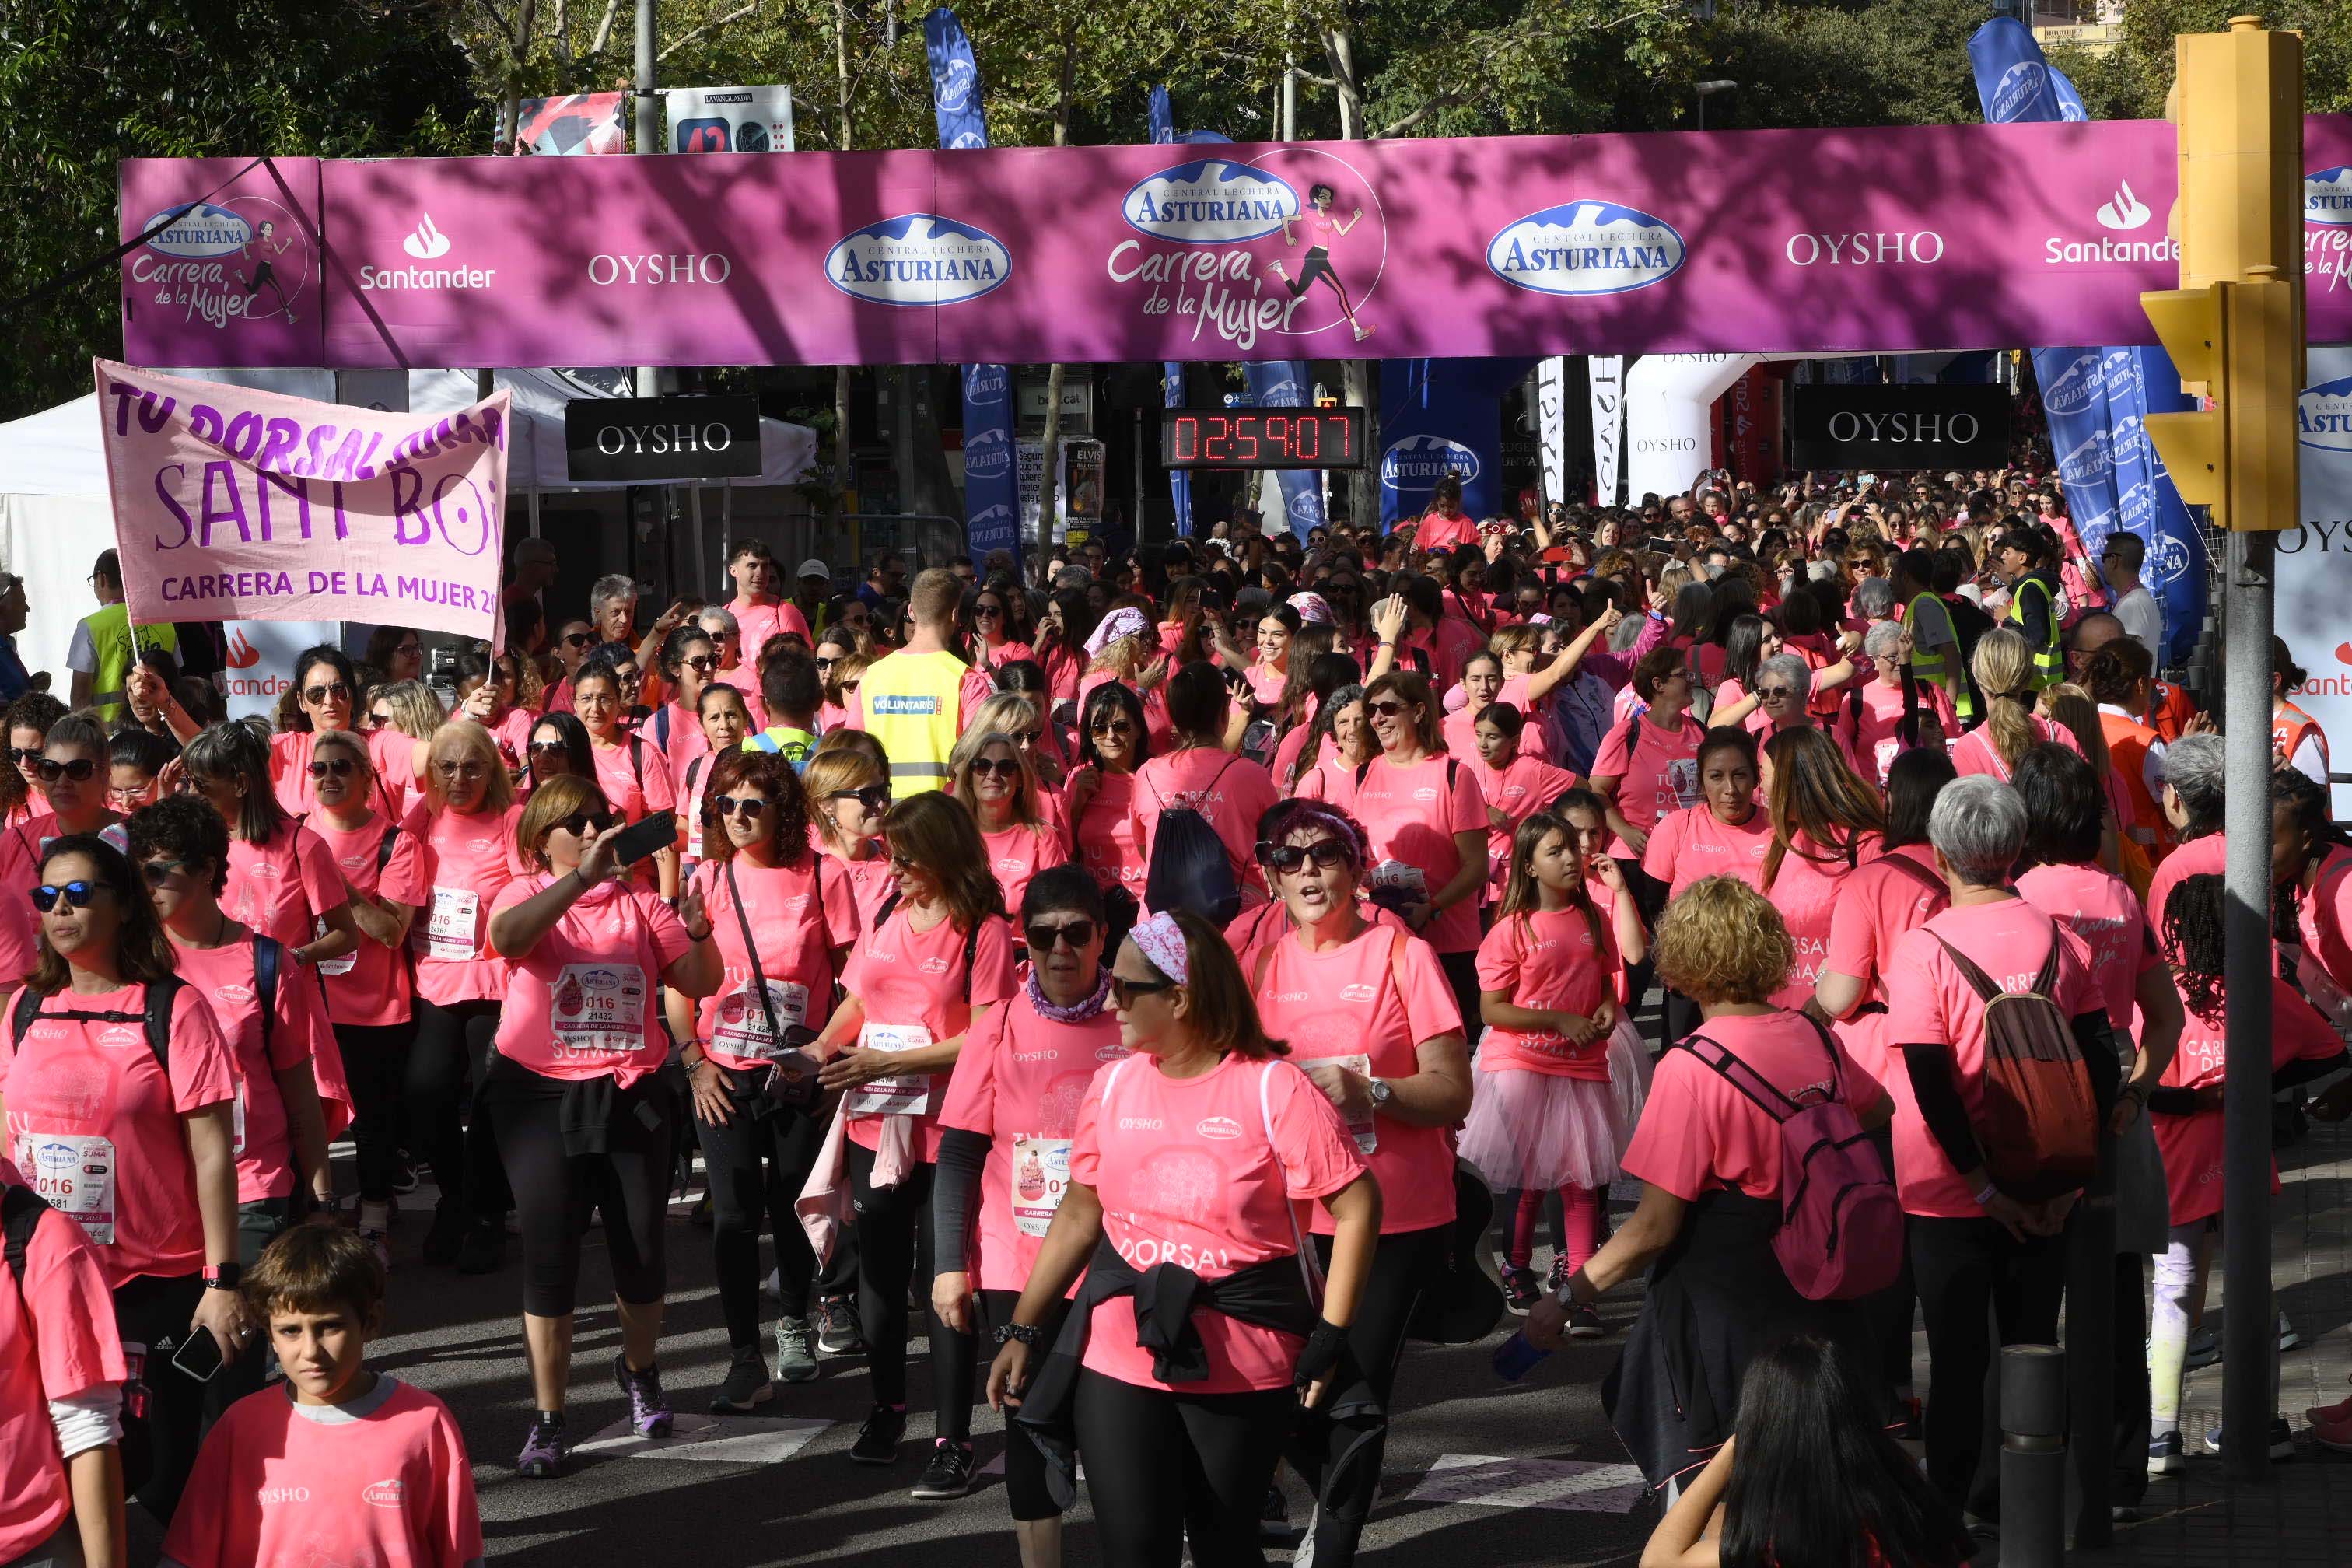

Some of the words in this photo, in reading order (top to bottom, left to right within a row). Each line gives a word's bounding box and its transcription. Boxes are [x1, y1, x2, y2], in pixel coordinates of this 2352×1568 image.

[1163, 187, 1219, 197] CENTRAL
[1223, 186, 1280, 195] LECHERA
[1136, 191, 1284, 222] ASTURIANA
[868, 246, 926, 255] CENTRAL
[933, 245, 990, 254] LECHERA
[1533, 233, 1594, 243] CENTRAL
[1601, 232, 1663, 242] LECHERA
[1786, 231, 1944, 266] OYSHO
[2046, 236, 2179, 264] Santande
[839, 248, 997, 282] ASTURIANA
[1108, 240, 1252, 282] Carrera
[1503, 236, 1670, 271] ASTURIANA
[132, 254, 223, 282] Carrera
[360, 264, 495, 289] Santander
[588, 253, 731, 285] OYSHO
[155, 285, 172, 304] de
[176, 283, 187, 304] la
[186, 282, 258, 328] Mujer
[1143, 285, 1170, 315] de
[1177, 283, 1195, 315] la
[1192, 278, 1307, 351] Mujer
[110, 382, 177, 436] TU
[189, 404, 384, 481] DORSAL
[597, 422, 731, 455] OYSHO
[1175, 416, 1349, 460] 02:59:07
[1829, 411, 1979, 443] OYSHO
[1077, 450, 1101, 460] ELVIS
[1636, 437, 1696, 453] OYSHO
[1384, 457, 1472, 479] ASTURIANA
[161, 572, 294, 603] CARRERA
[308, 572, 348, 595] DE
[356, 572, 388, 597] LA
[397, 576, 476, 611] MUJER
[874, 700, 934, 710] VOLUNTARIS
[1376, 873, 1398, 886] 016
[431, 914, 450, 925] 016
[586, 996, 614, 1010] 016
[1014, 1049, 1058, 1062] OYSHO
[1120, 1118, 1163, 1130] OYSHO
[39, 1177, 73, 1194] 016
[257, 1486, 310, 1506] OYSHO
